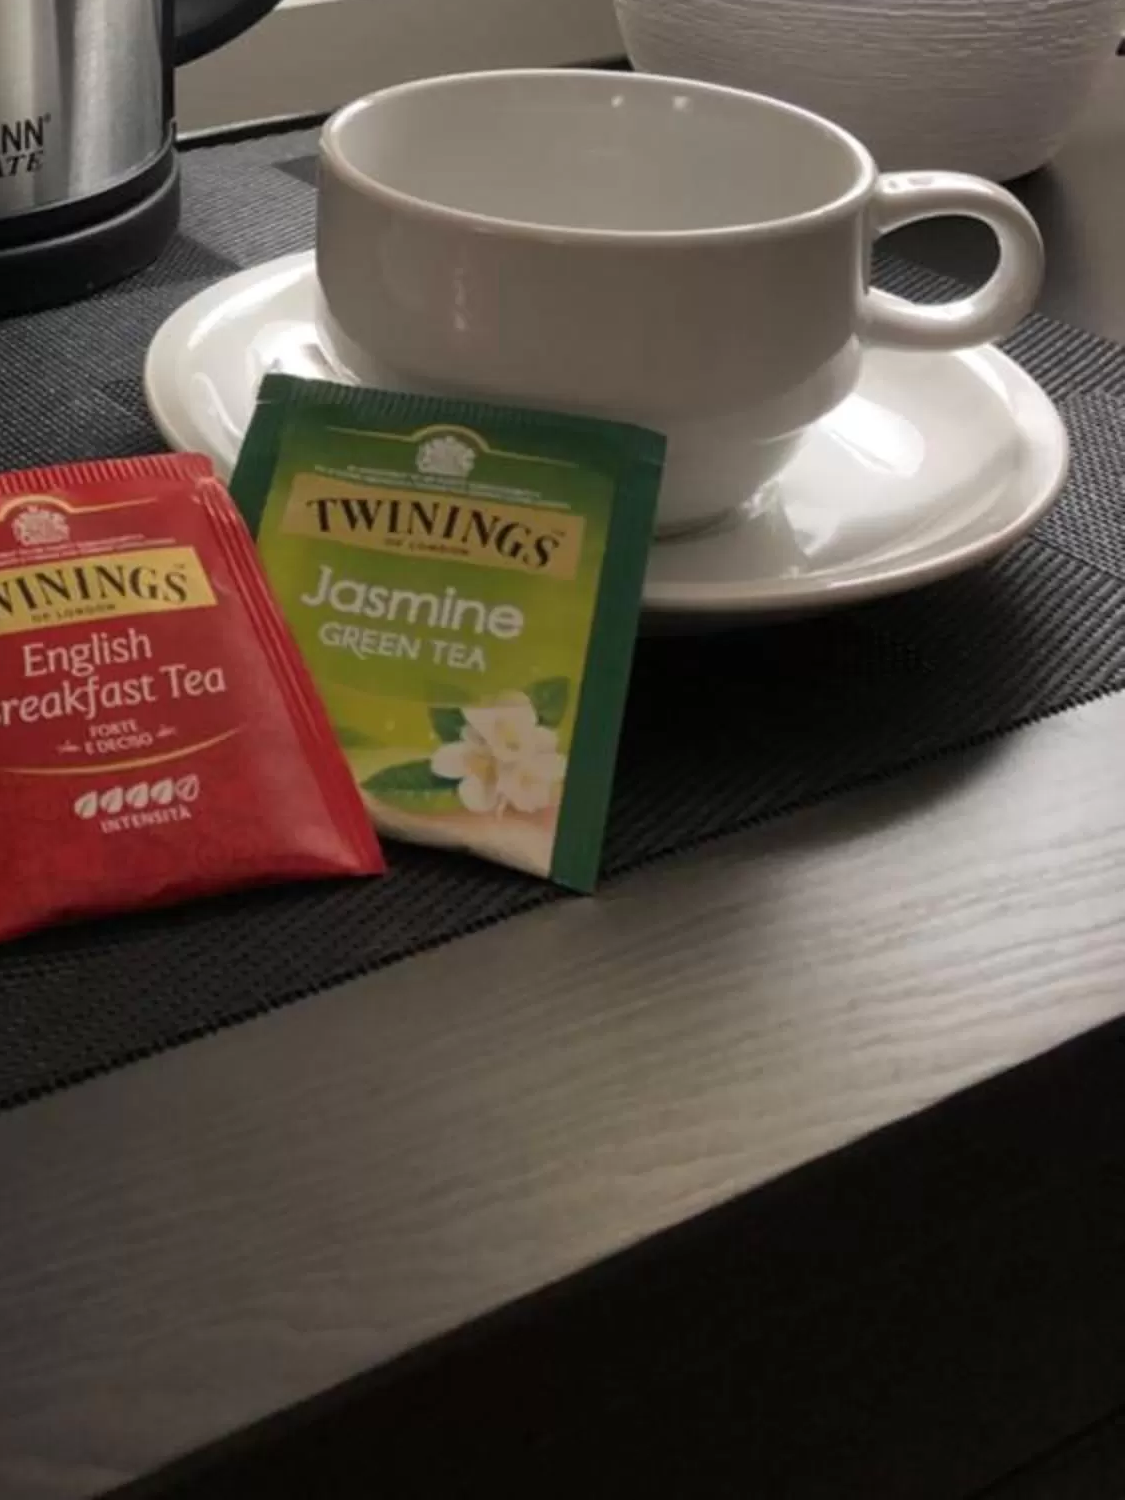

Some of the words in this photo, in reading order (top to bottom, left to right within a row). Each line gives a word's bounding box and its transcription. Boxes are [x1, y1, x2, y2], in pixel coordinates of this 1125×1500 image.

[307, 498, 560, 567] TWININGS
[301, 564, 524, 639] Jasmine
[23, 628, 153, 678] English
[319, 621, 421, 661] GREEN
[430, 639, 487, 672] TEA
[159, 663, 227, 699] Tea
